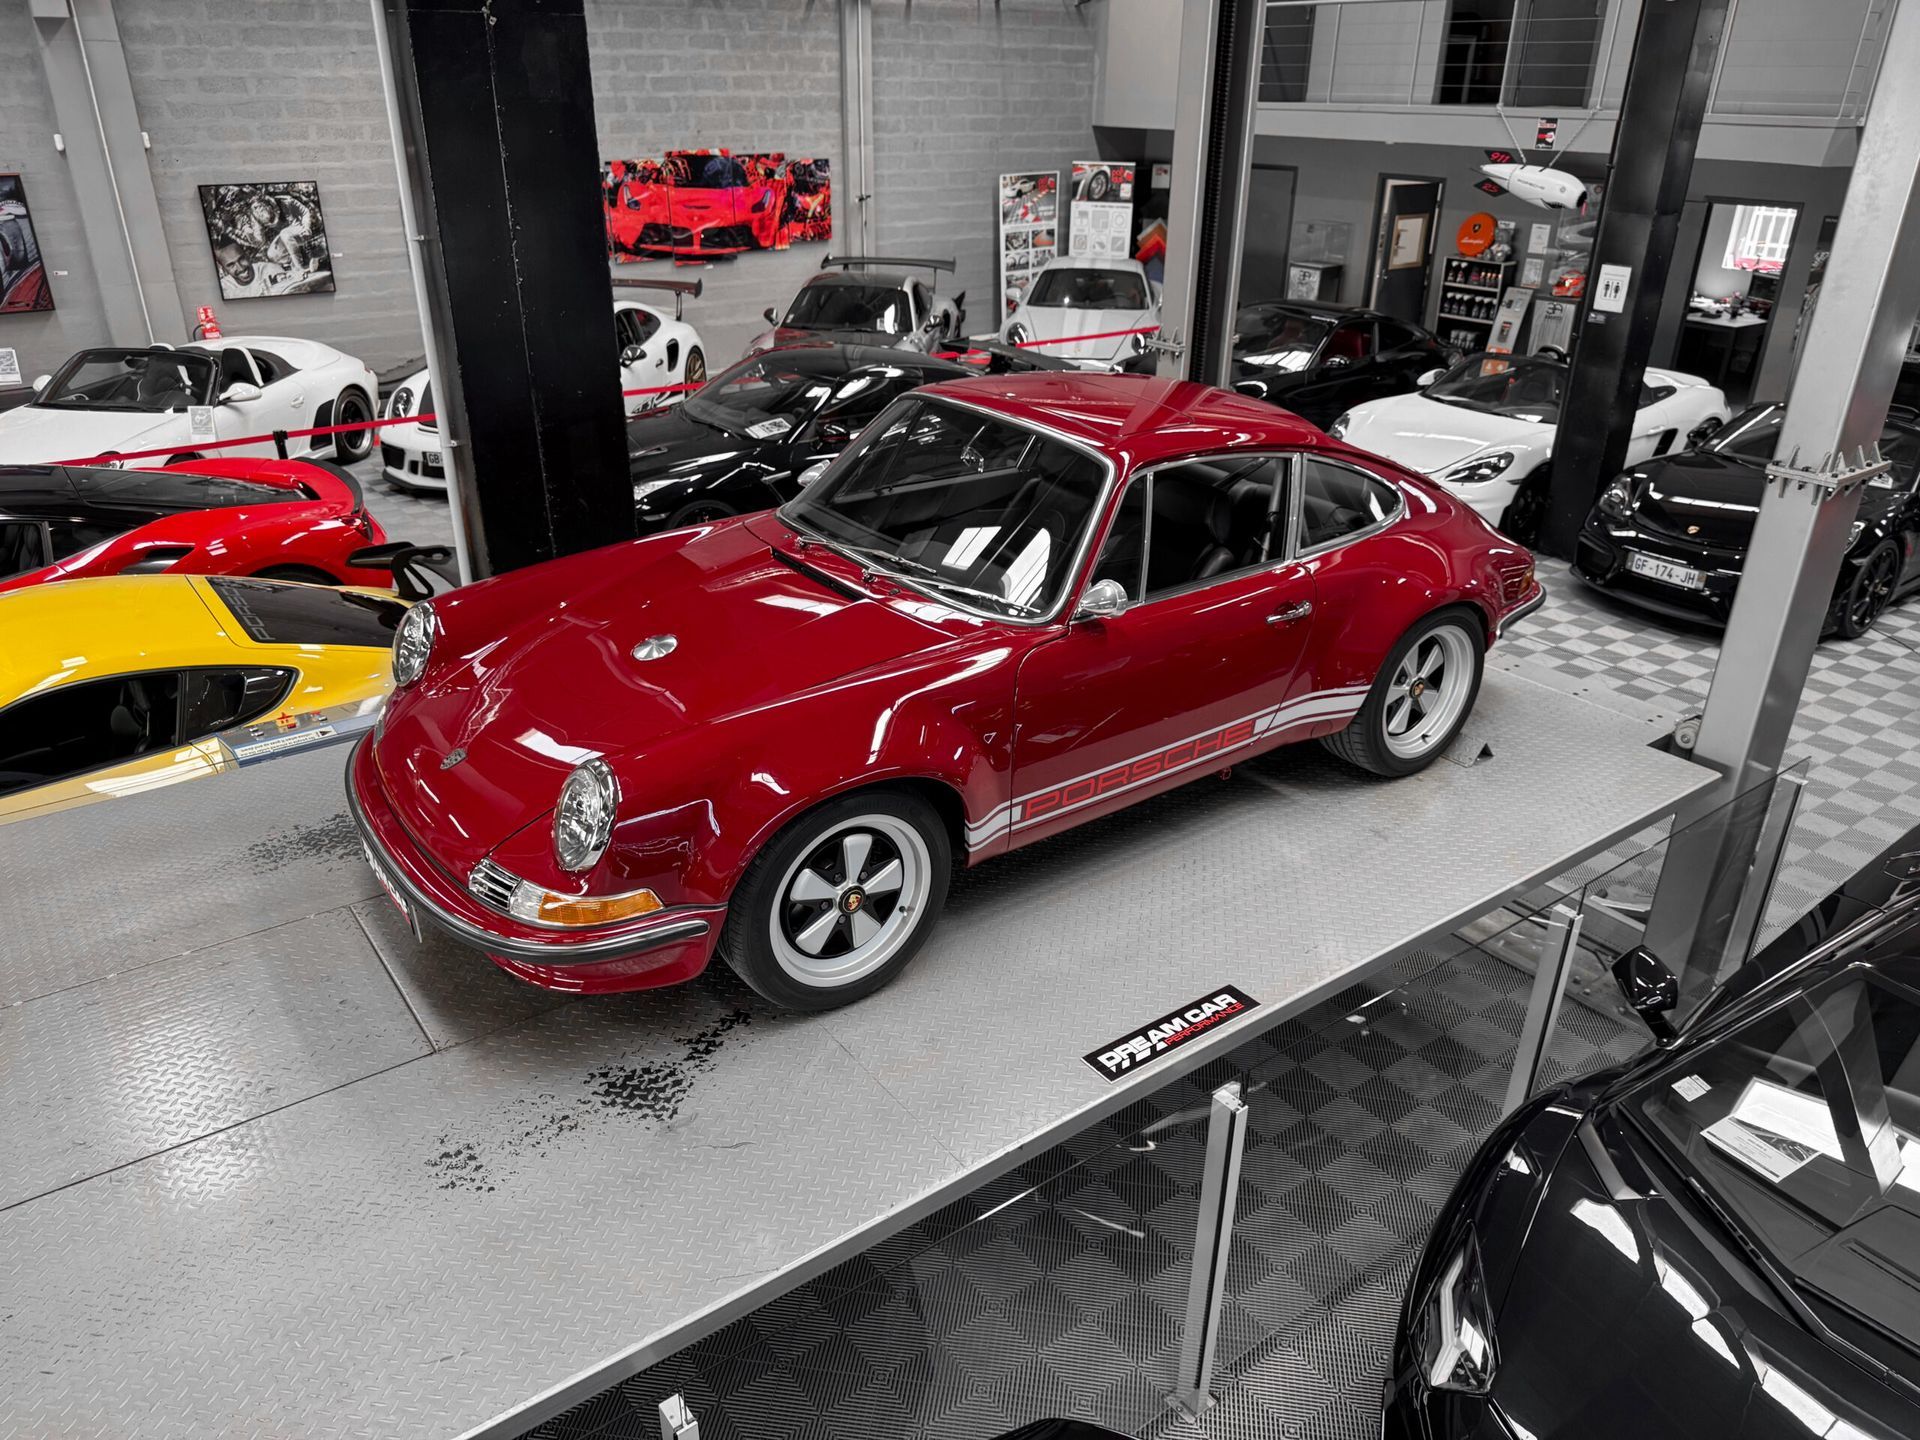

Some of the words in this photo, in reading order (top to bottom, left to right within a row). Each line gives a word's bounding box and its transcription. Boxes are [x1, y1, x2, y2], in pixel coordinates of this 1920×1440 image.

[1490, 152, 1510, 163] 911
[1634, 558, 1696, 586] GF-174-JH
[206, 576, 276, 640] PORSC
[1023, 720, 1254, 819] PORSCHE
[1097, 1017, 1190, 1070] DREAM
[1184, 993, 1238, 1024] CAR
[1164, 1002, 1245, 1046] PERFORMANCE
